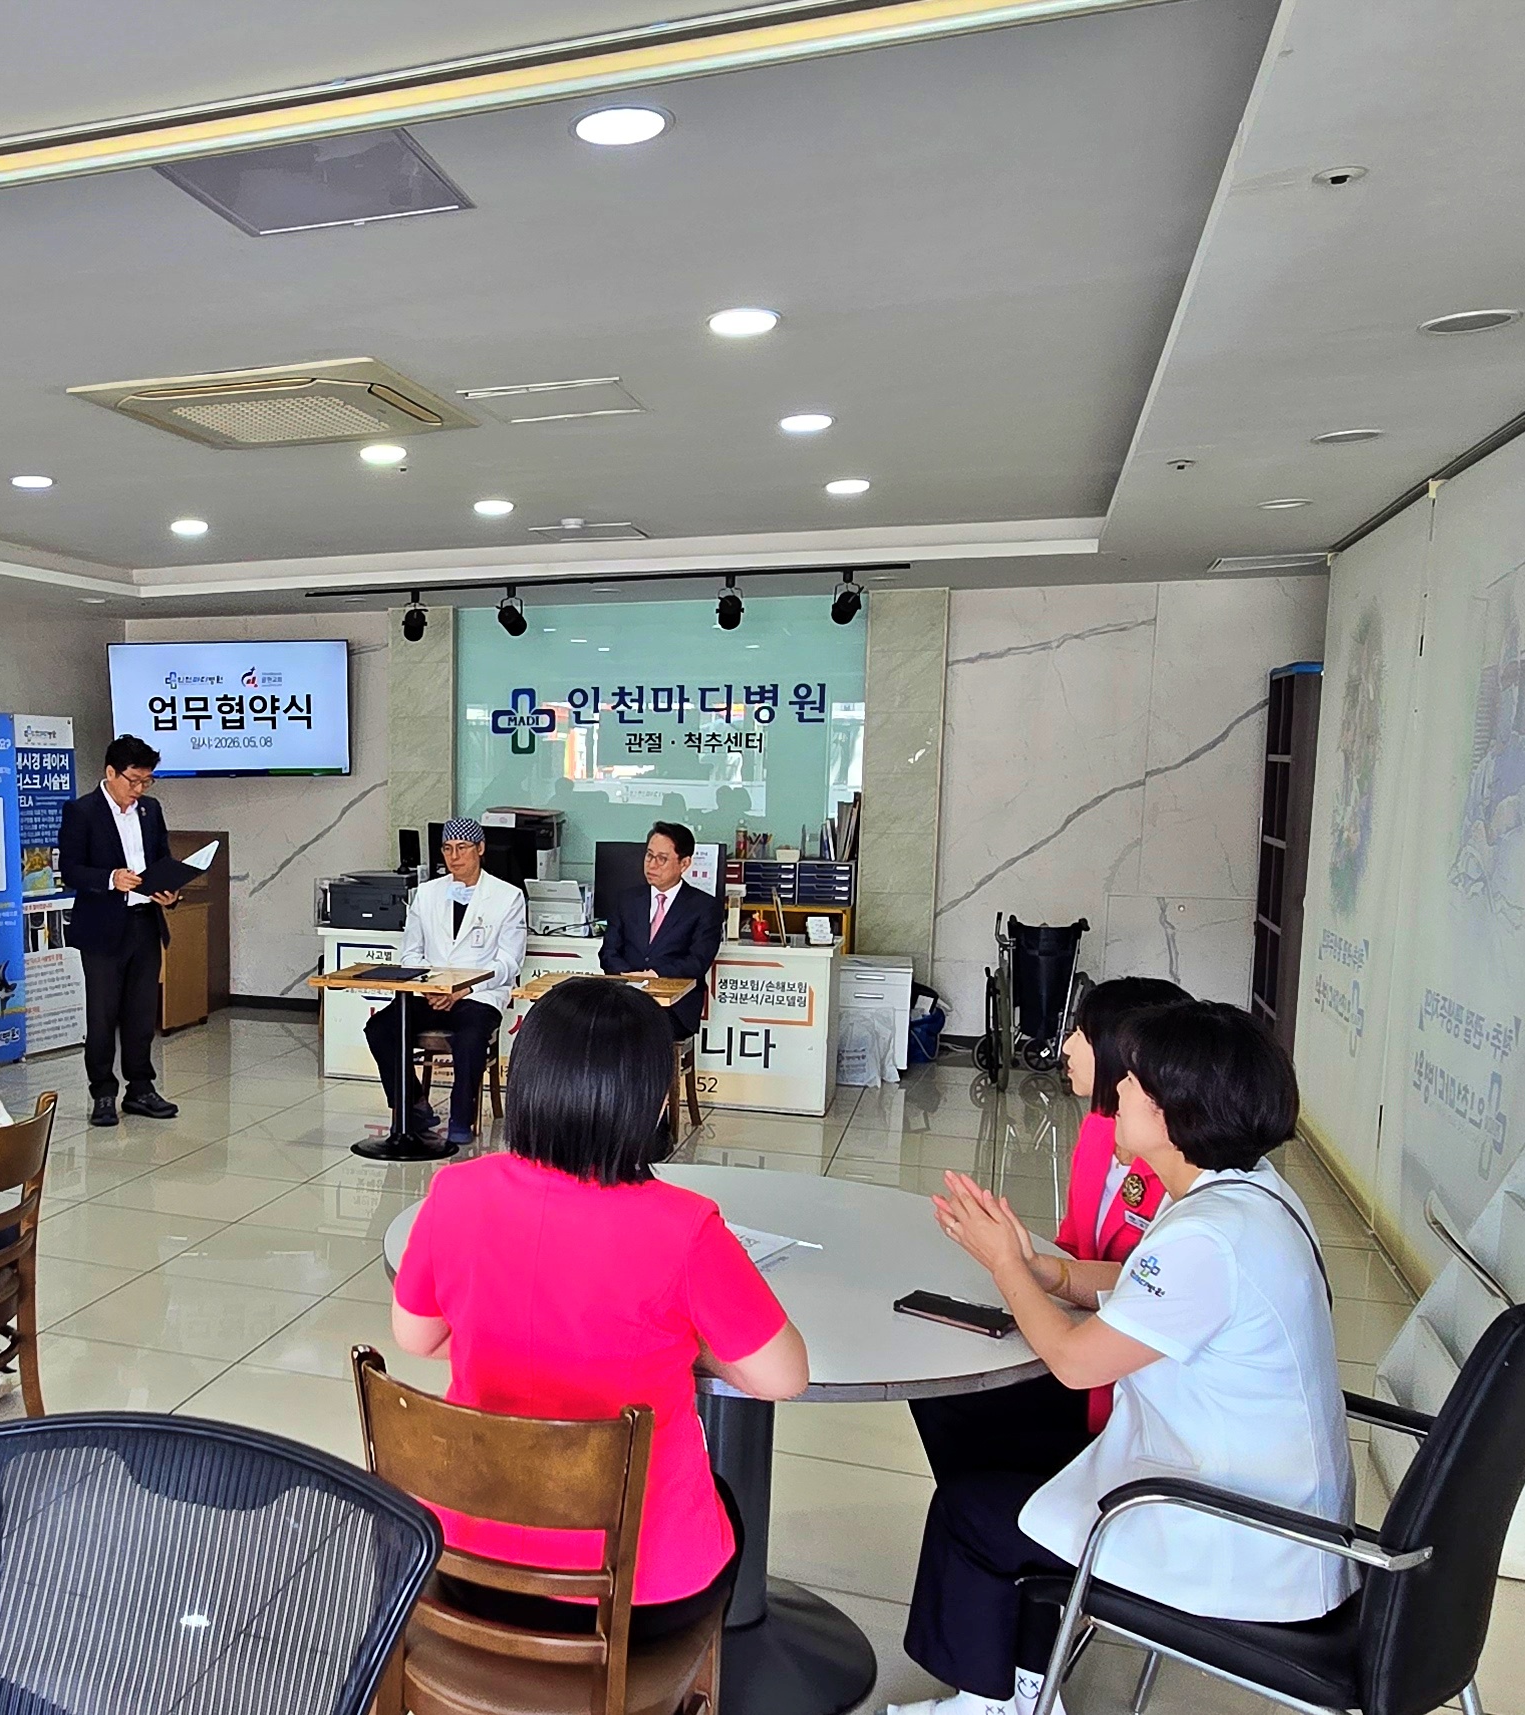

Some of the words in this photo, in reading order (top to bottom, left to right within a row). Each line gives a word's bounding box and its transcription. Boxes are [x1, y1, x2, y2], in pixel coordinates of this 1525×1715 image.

[567, 683, 826, 724] 인천마디병원
[148, 694, 312, 731] 업무협약식
[507, 715, 540, 727] MADI
[625, 732, 662, 753] 관절
[683, 732, 763, 754] 척추센터
[42, 753, 69, 770] 레이저
[42, 773, 70, 790] 시술법
[366, 950, 392, 961] 사고별
[718, 979, 807, 993] 생명보험/손해보험
[717, 992, 807, 1007] 증권분석/리모델링
[701, 1027, 776, 1069] 니다
